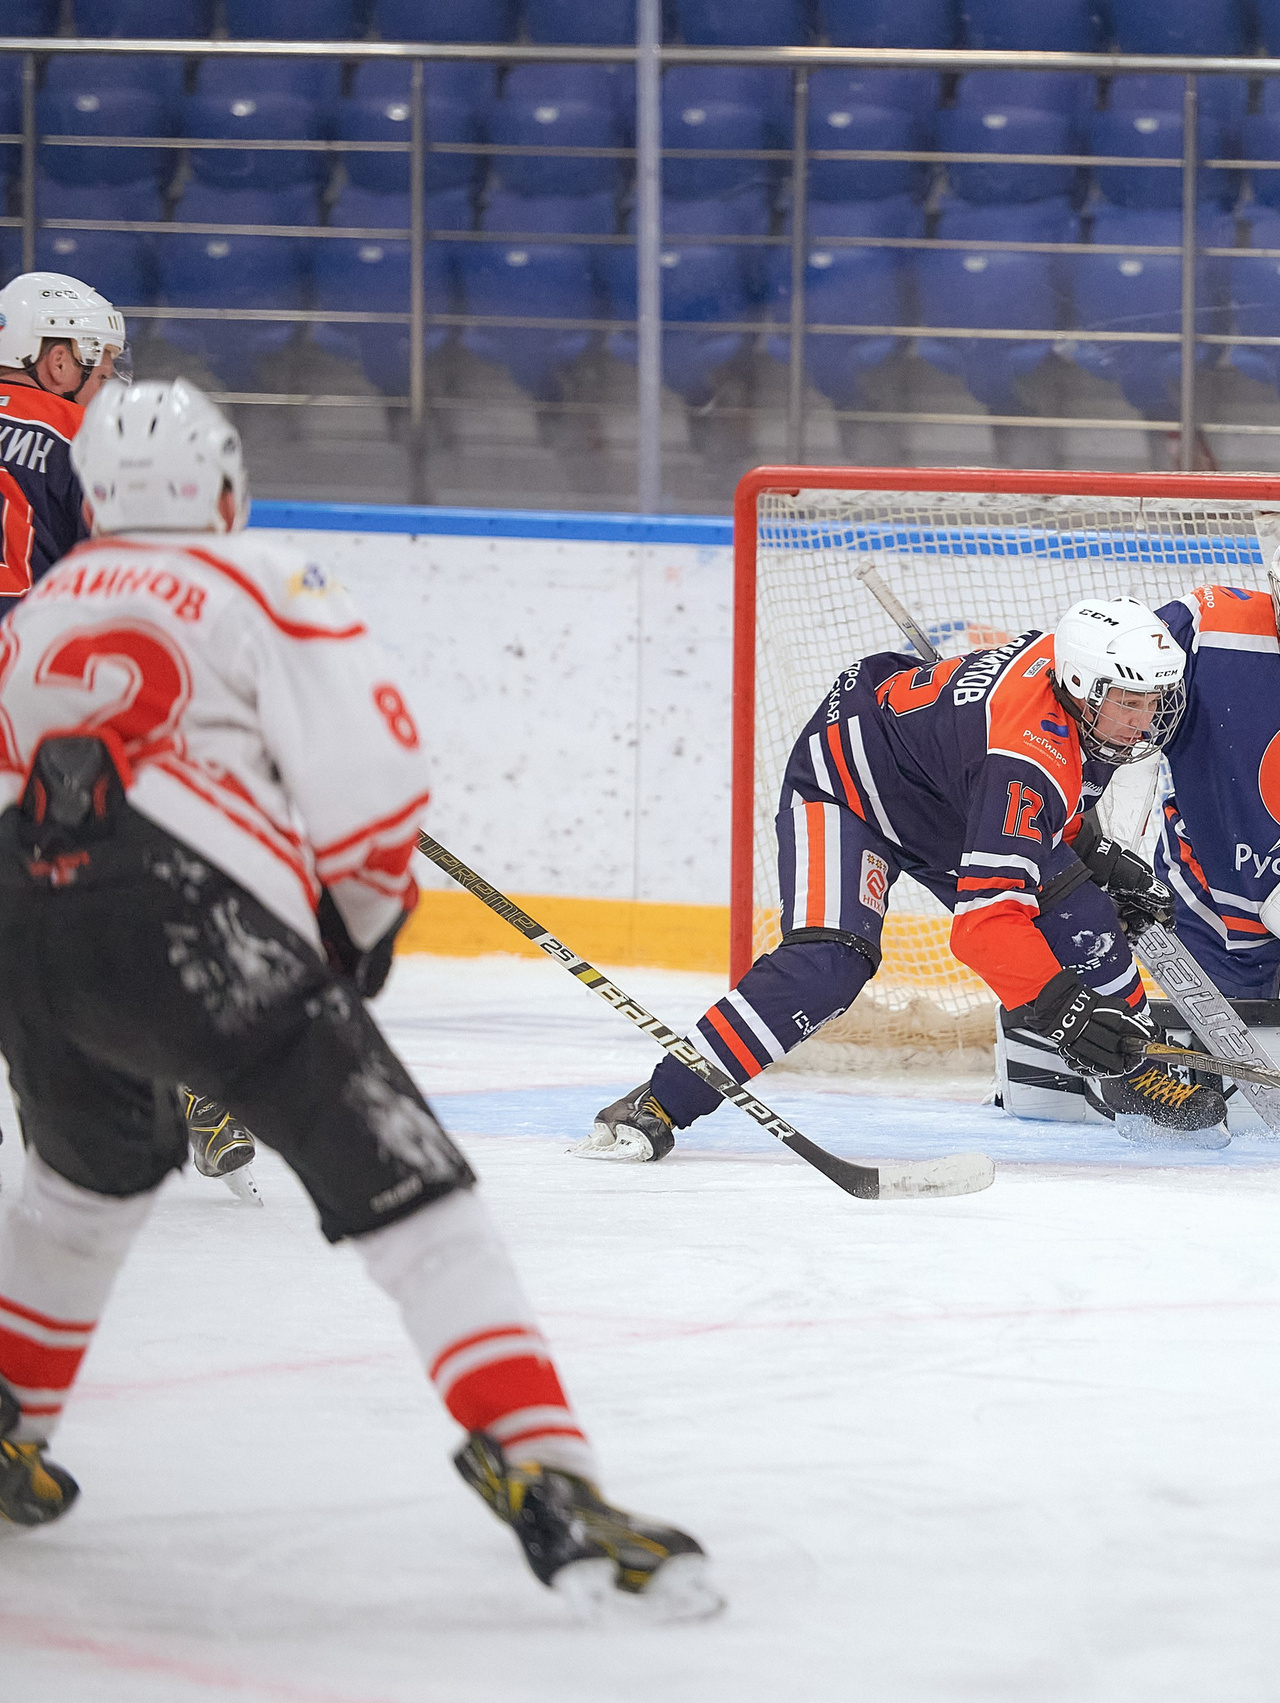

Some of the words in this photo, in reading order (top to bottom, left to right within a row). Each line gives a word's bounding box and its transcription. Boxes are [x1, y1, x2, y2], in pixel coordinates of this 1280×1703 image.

[1078, 608, 1120, 627] CCM
[0, 616, 193, 768] 2
[1155, 669, 1179, 678] CCM
[372, 685, 420, 751] 8
[1023, 729, 1067, 766] РусГидро
[1002, 780, 1045, 844] 12
